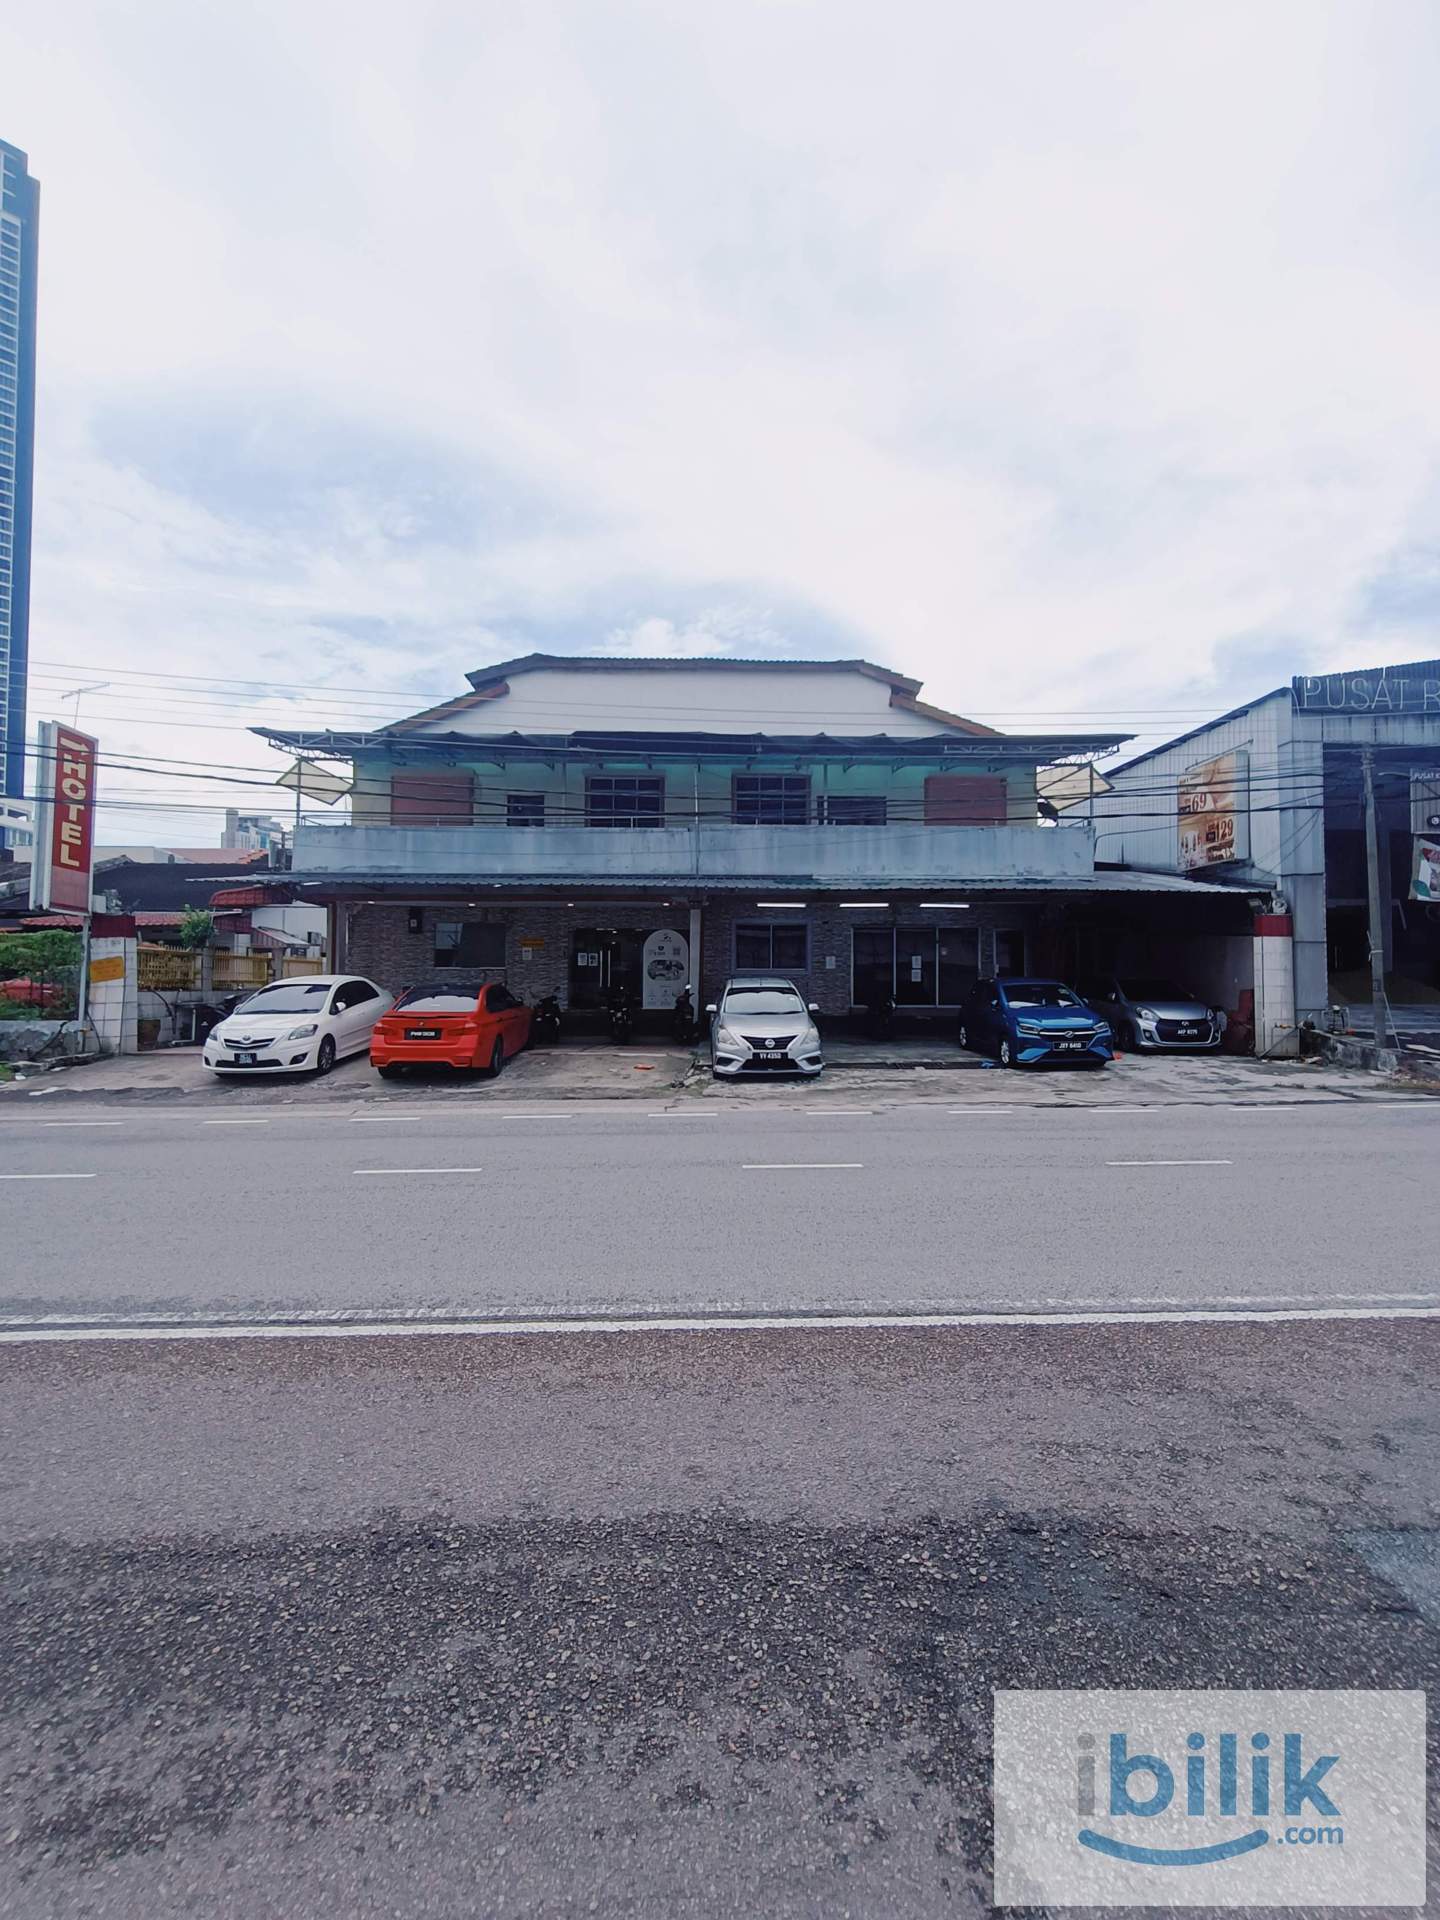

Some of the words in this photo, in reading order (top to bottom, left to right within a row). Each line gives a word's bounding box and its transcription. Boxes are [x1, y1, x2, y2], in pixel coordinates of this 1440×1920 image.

[1303, 677, 1410, 710] PUSAT
[60, 753, 87, 867] HOTEL
[1215, 818, 1234, 842] 129
